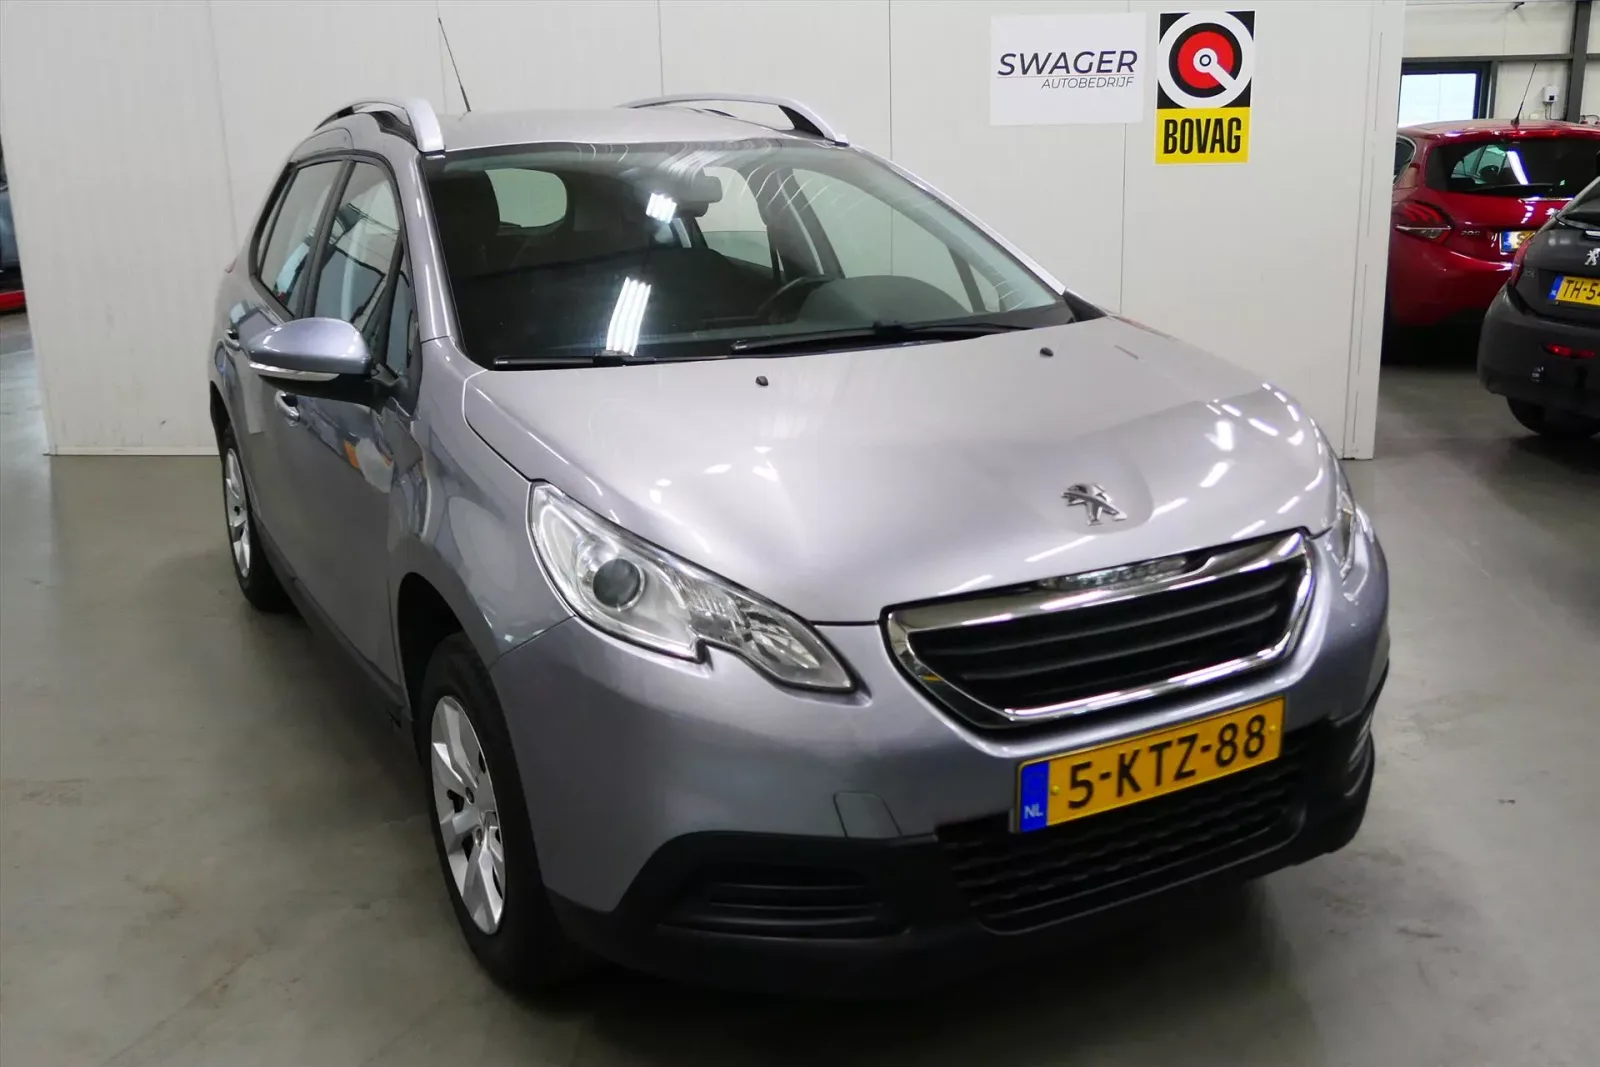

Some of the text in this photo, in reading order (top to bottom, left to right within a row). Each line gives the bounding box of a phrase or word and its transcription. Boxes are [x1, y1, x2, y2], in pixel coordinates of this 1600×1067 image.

[998, 50, 1138, 76] SWAGER
[1041, 76, 1134, 90] AUTOBEDRIJF
[1163, 117, 1242, 154] BOVAG
[1563, 280, 1600, 300] TH-5
[1068, 714, 1266, 810] 5-KTZ-88
[1024, 804, 1043, 819] NL
